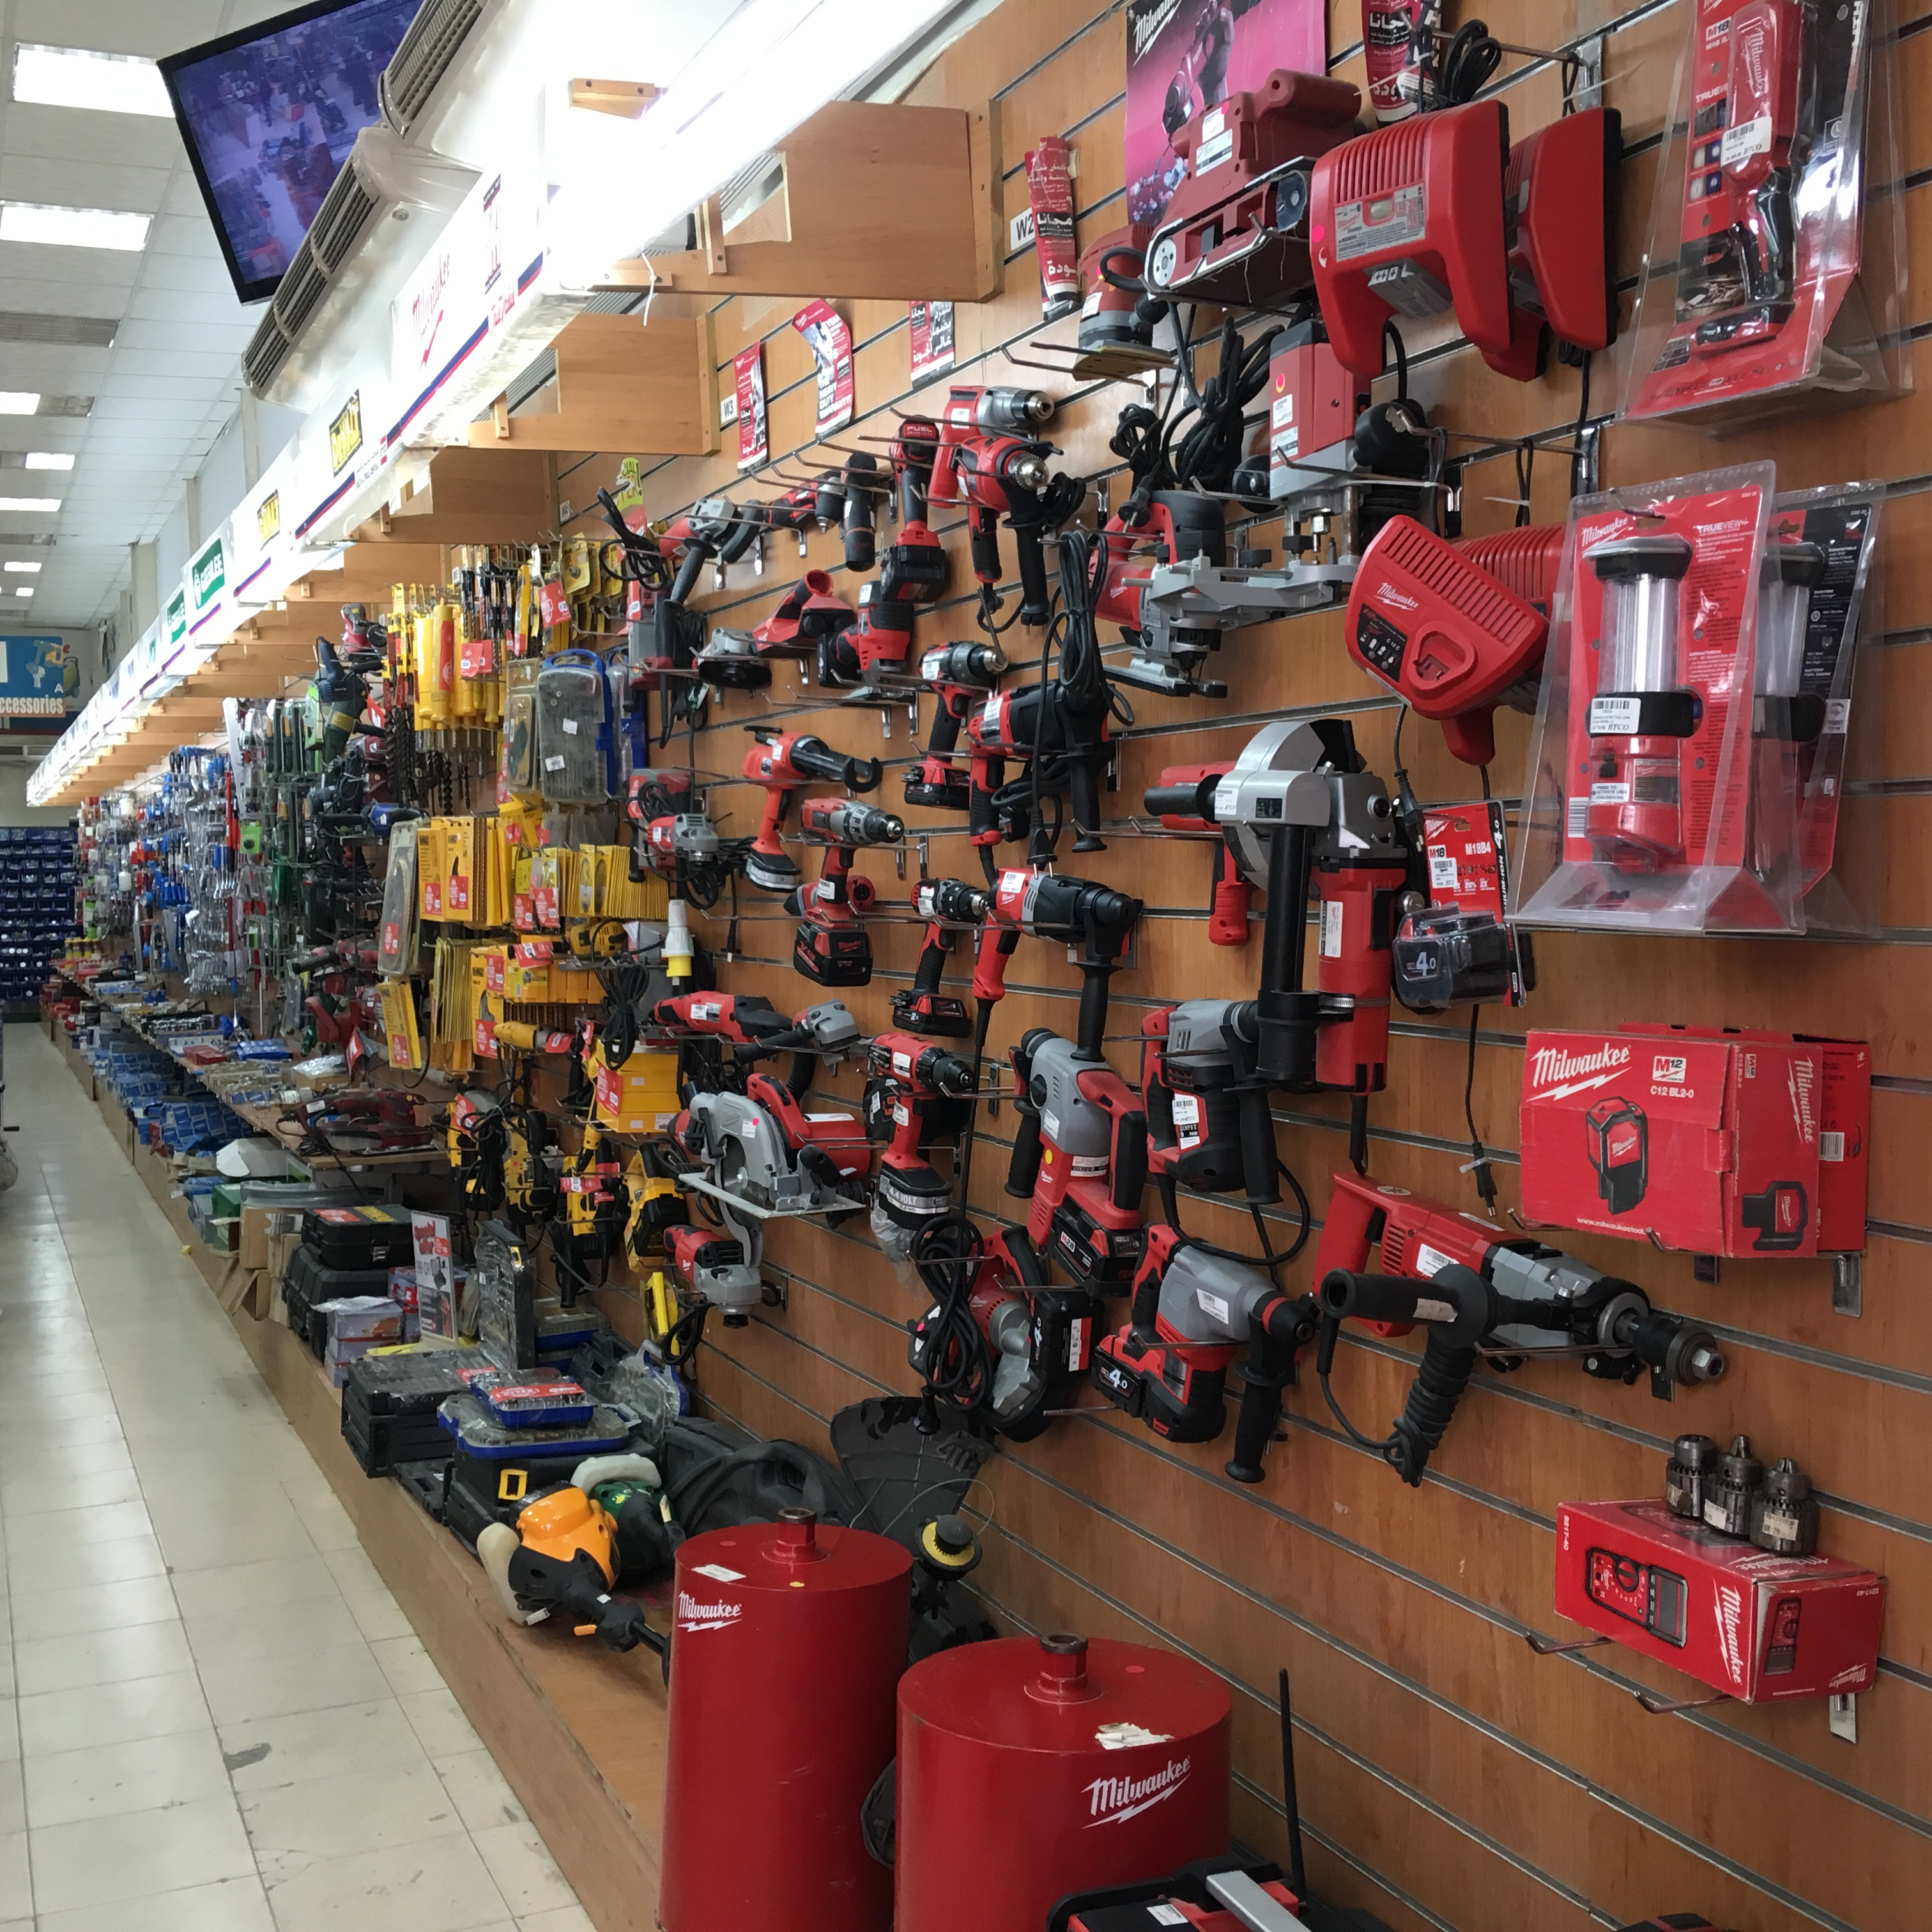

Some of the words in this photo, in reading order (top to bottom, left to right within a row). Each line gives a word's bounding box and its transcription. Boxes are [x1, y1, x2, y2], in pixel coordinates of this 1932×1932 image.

[1016, 213, 1034, 241] W2
[1037, 212, 1073, 229] مجانا
[723, 399, 734, 418] W3
[819, 392, 835, 409] DUTY
[1581, 516, 1629, 547] Milwaukee
[1377, 582, 1419, 608] Milwaukee
[1429, 847, 1445, 859] M18
[1465, 841, 1492, 855] M18B4
[1416, 951, 1436, 976] 4.0
[1529, 1042, 1630, 1087] Milwaukee
[1656, 1057, 1683, 1073] M12
[1650, 1085, 1667, 1096] C12
[1669, 1087, 1694, 1098] BL2-0
[1794, 1055, 1816, 1144] Milwaukee
[900, 1195, 917, 1205] VOLT
[1576, 1217, 1660, 1238] www.milwaukeetool.m
[1109, 1369, 1128, 1389] 4.0
[678, 1590, 742, 1620] Milwaukee
[1721, 1585, 1744, 1685] Milwaukee
[1081, 1757, 1191, 1816] Milwaukee
